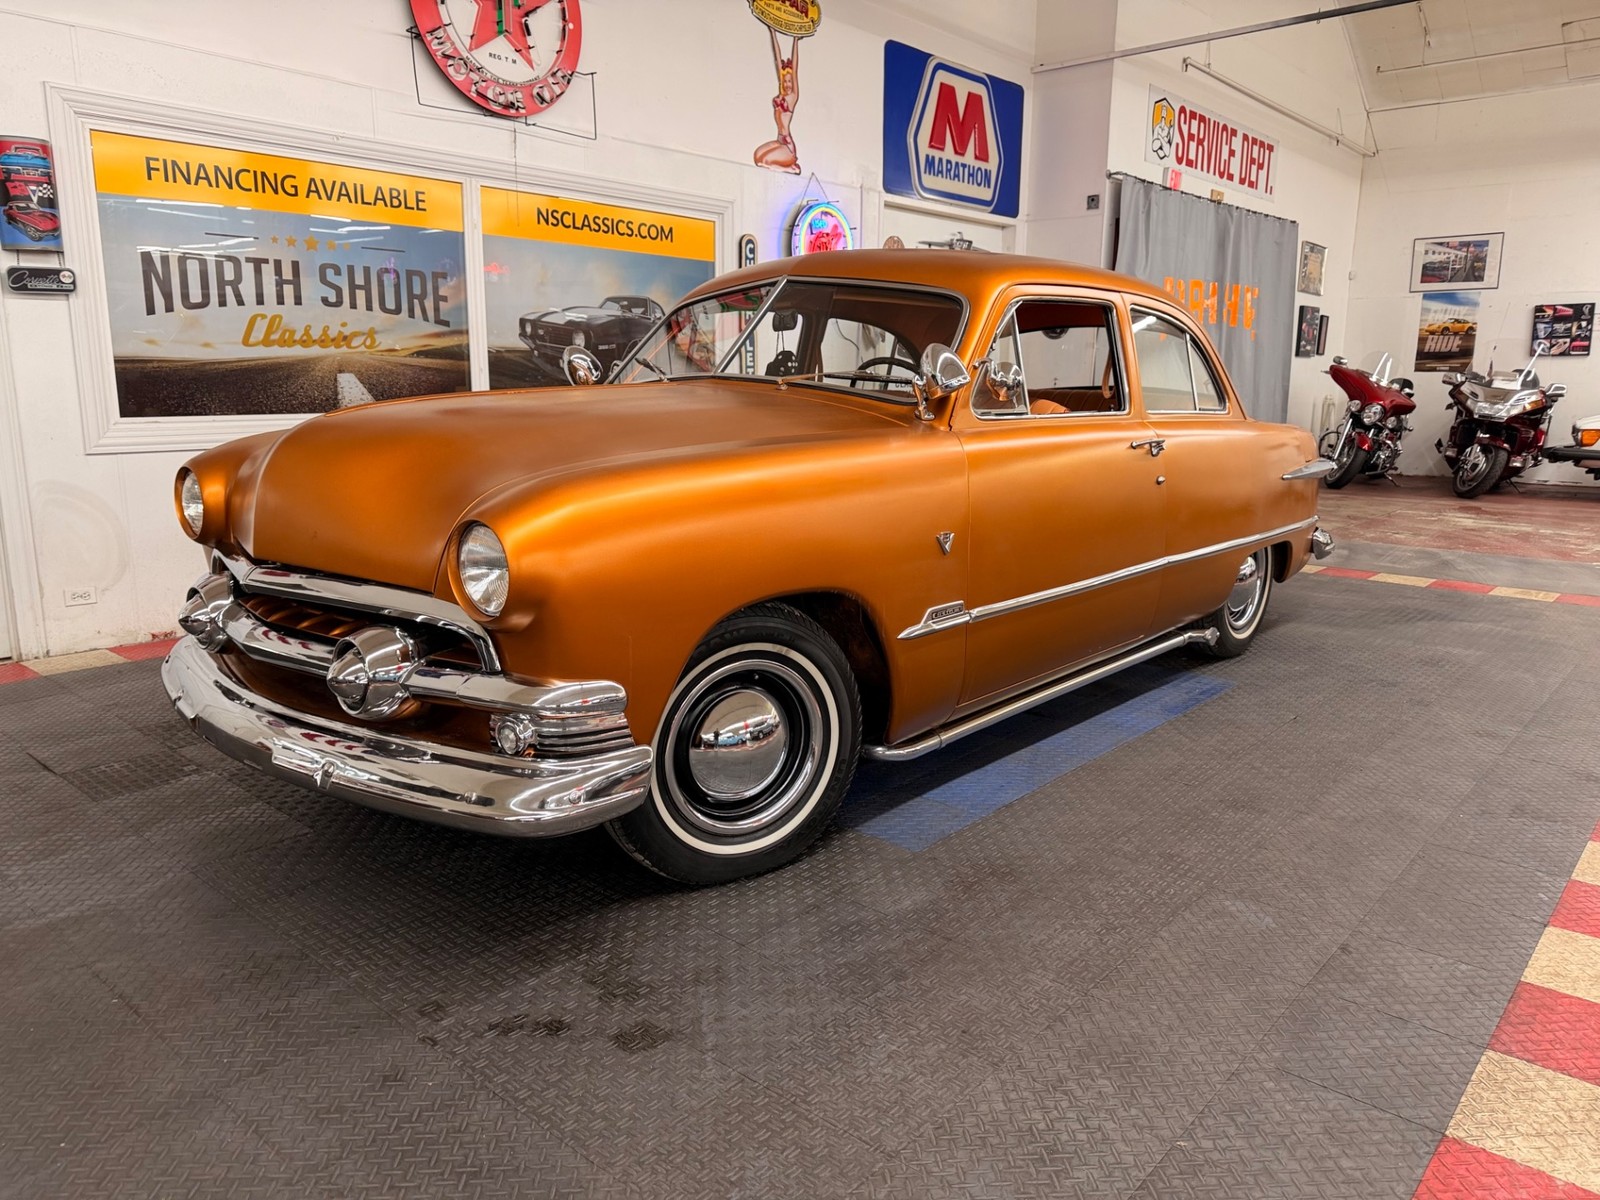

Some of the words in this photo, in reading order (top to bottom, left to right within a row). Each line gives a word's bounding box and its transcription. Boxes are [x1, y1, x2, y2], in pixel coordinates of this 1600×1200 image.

[426, 25, 526, 114] MOTOR
[928, 82, 989, 163] M
[924, 154, 992, 189] MARATHON
[1175, 105, 1238, 183] SERVICE
[1238, 132, 1274, 195] DEPT.
[144, 156, 300, 198] FINANCING
[305, 177, 427, 212] AVAILABLE
[536, 207, 674, 243] NSCLASSICS.COM
[9, 270, 61, 287] Corvette
[139, 250, 304, 317] NORTH
[319, 262, 451, 328] SHORE
[241, 313, 382, 351] Classics
[1424, 335, 1464, 353] RIDE
